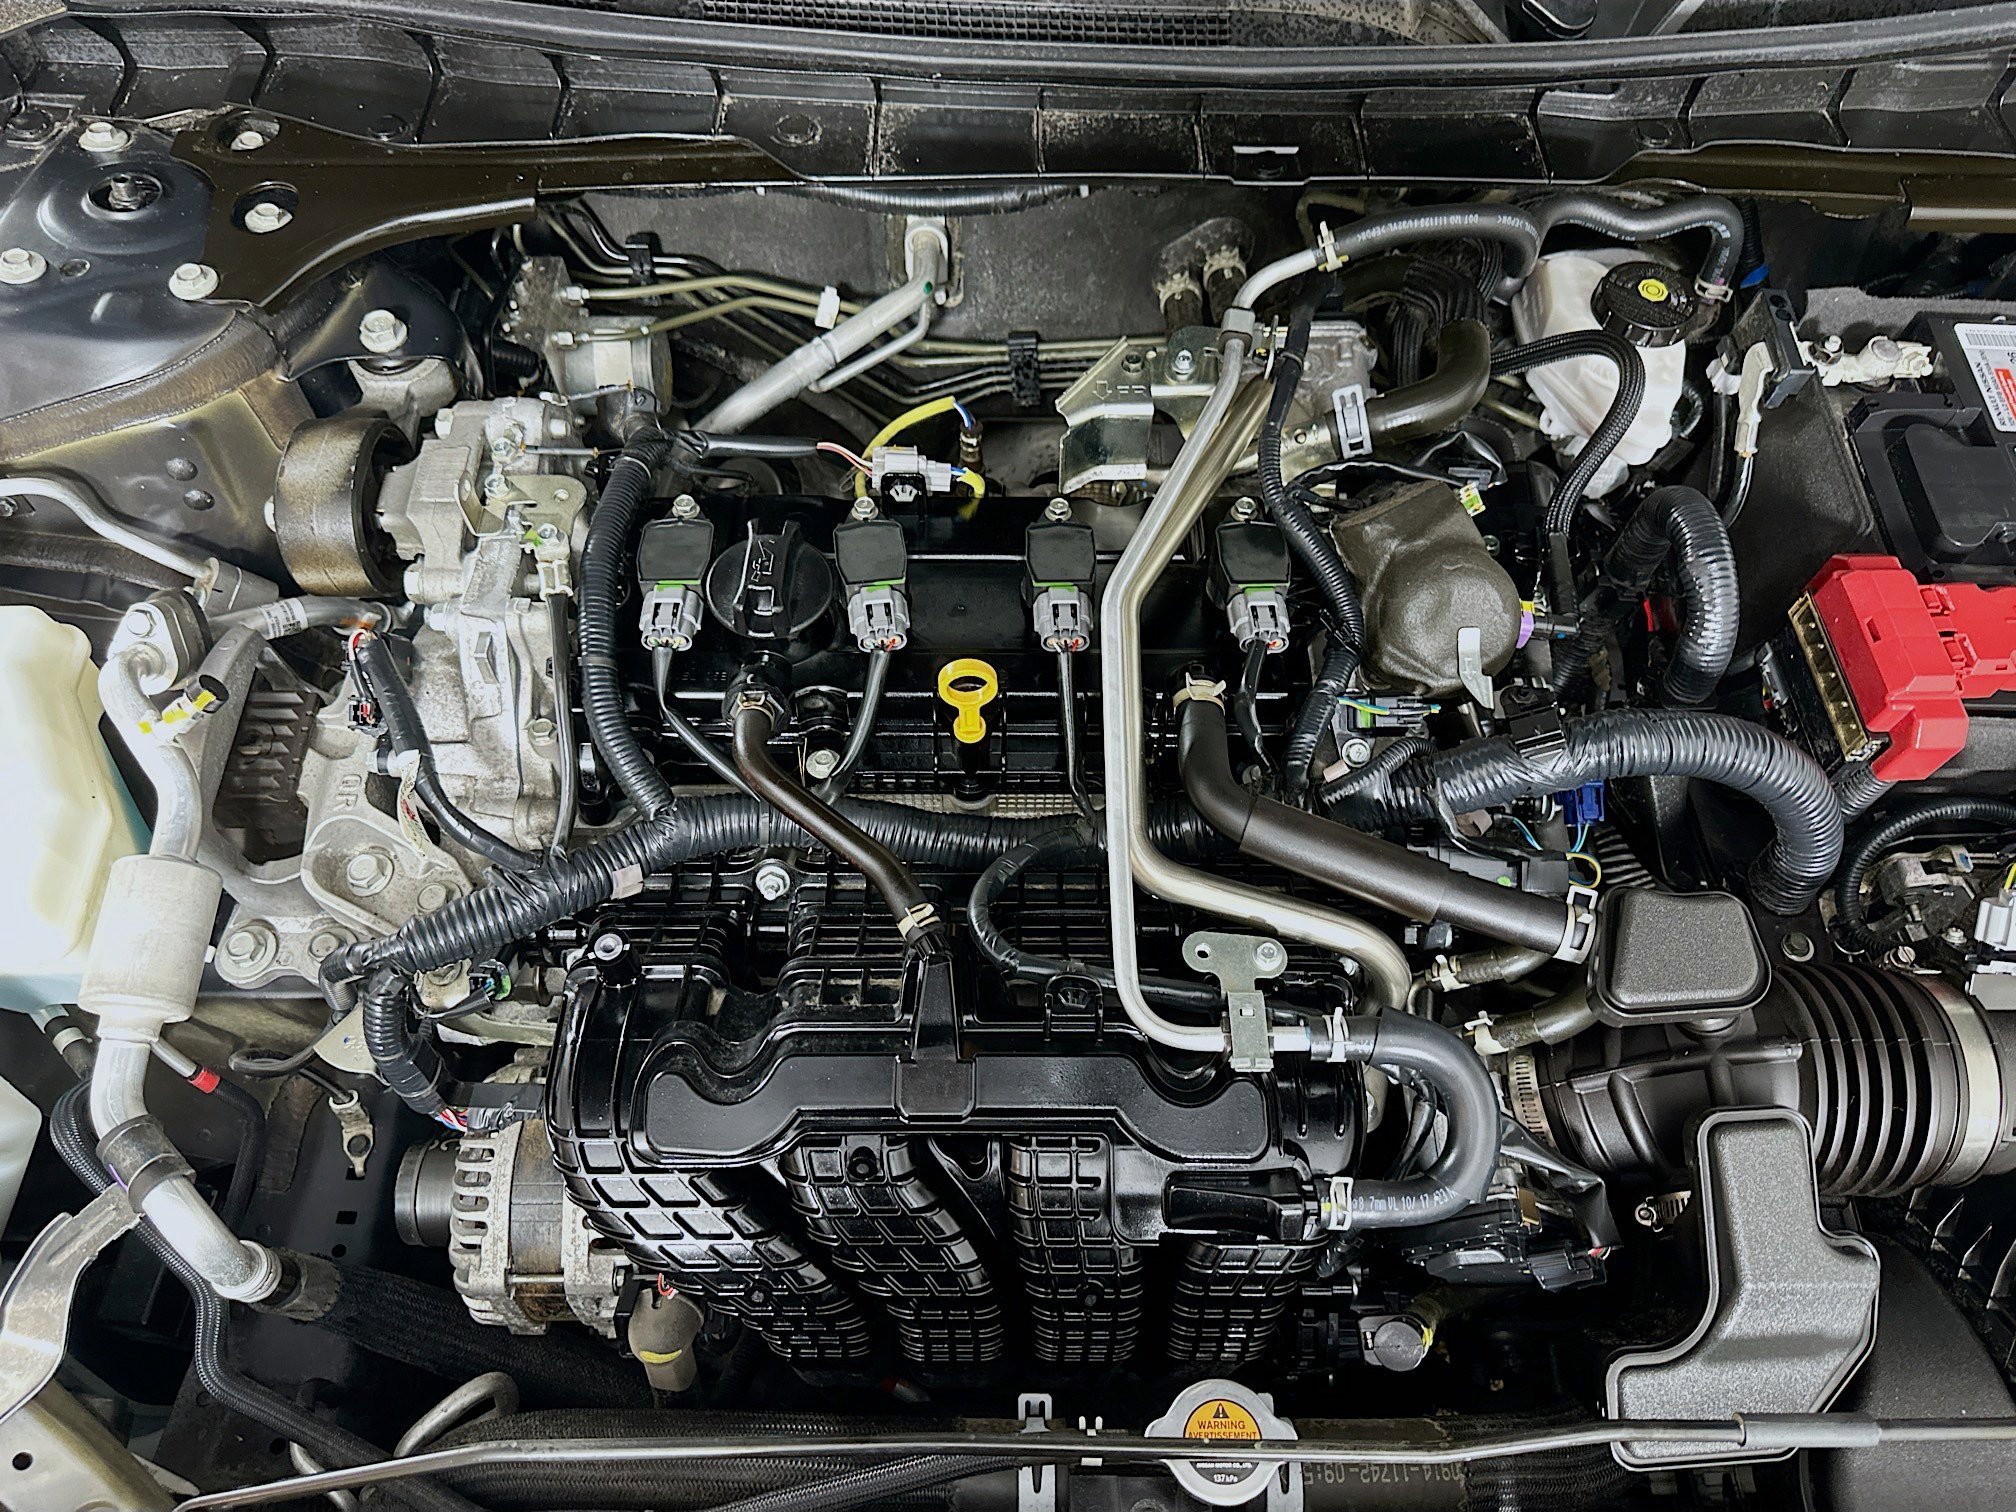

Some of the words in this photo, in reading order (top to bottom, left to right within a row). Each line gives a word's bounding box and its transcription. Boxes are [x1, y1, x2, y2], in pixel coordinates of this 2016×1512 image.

[1197, 1420, 1246, 1430] WARNING
[1188, 1431, 1257, 1439] AVERTISSEMENT
[1213, 1473, 1225, 1483] 137
[1225, 1474, 1238, 1483] kPa
